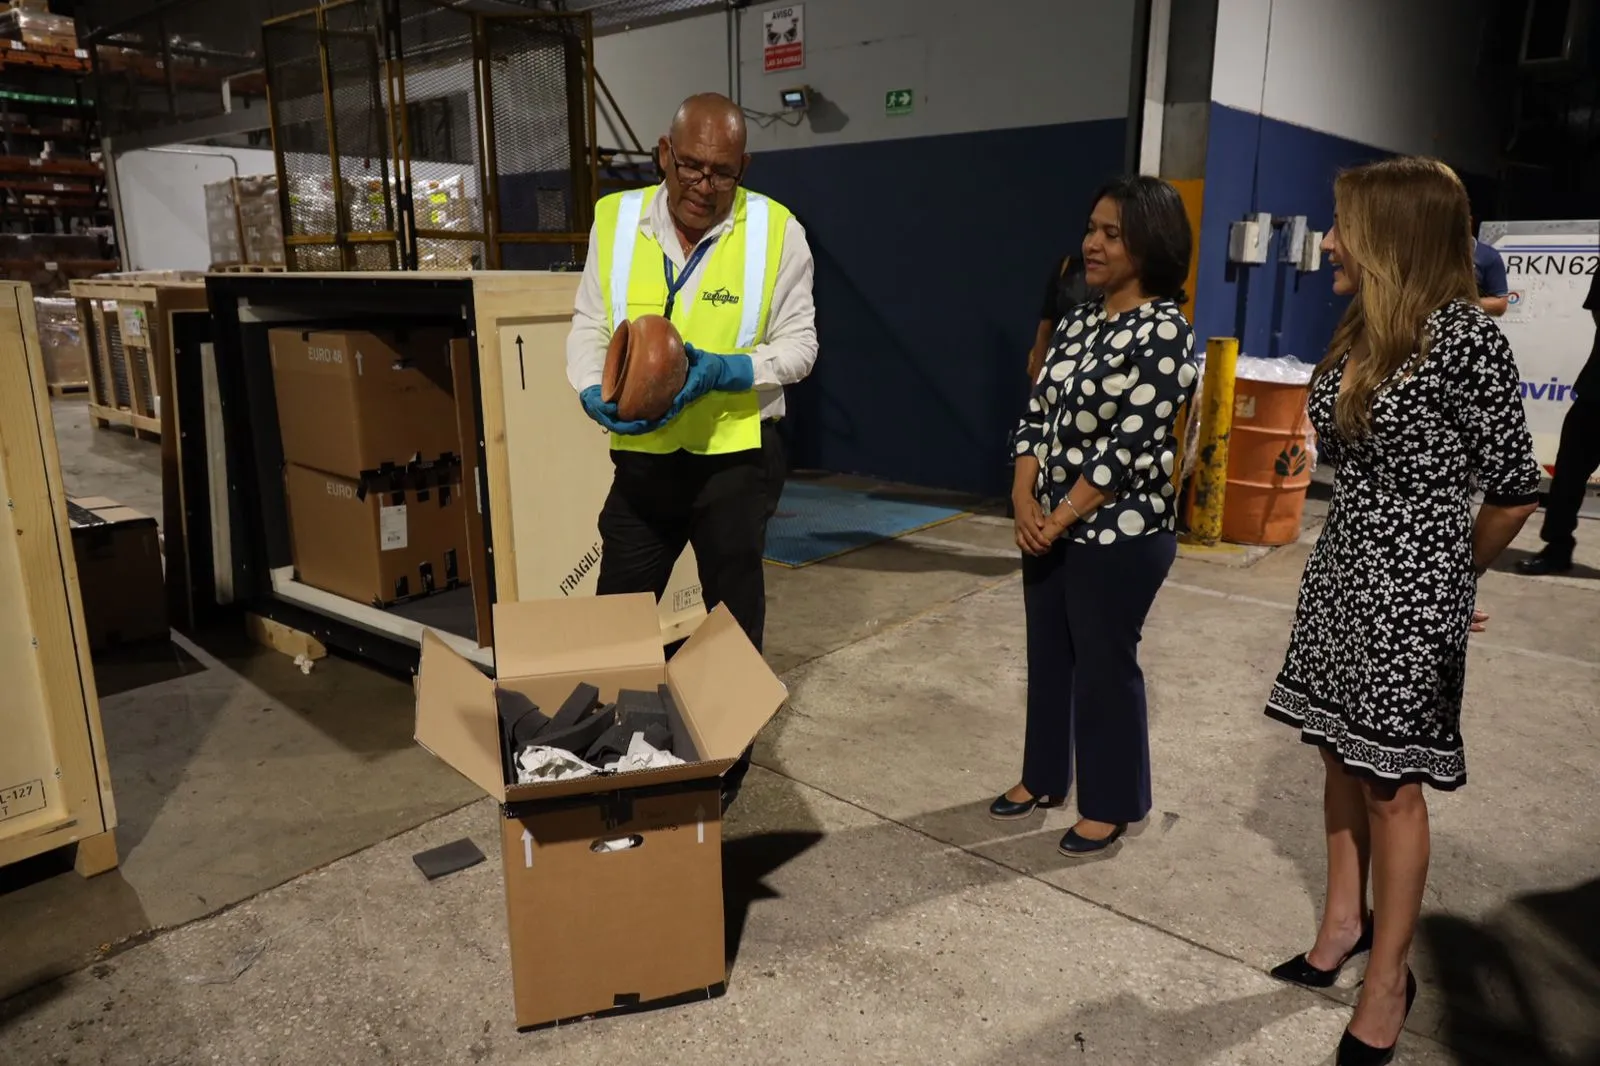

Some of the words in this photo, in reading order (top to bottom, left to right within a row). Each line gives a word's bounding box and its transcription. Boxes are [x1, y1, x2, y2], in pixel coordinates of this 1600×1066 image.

[772, 8, 793, 20] AVISO
[308, 346, 331, 363] EURO
[326, 481, 353, 499] EURO
[560, 541, 603, 597] FRAGILE
